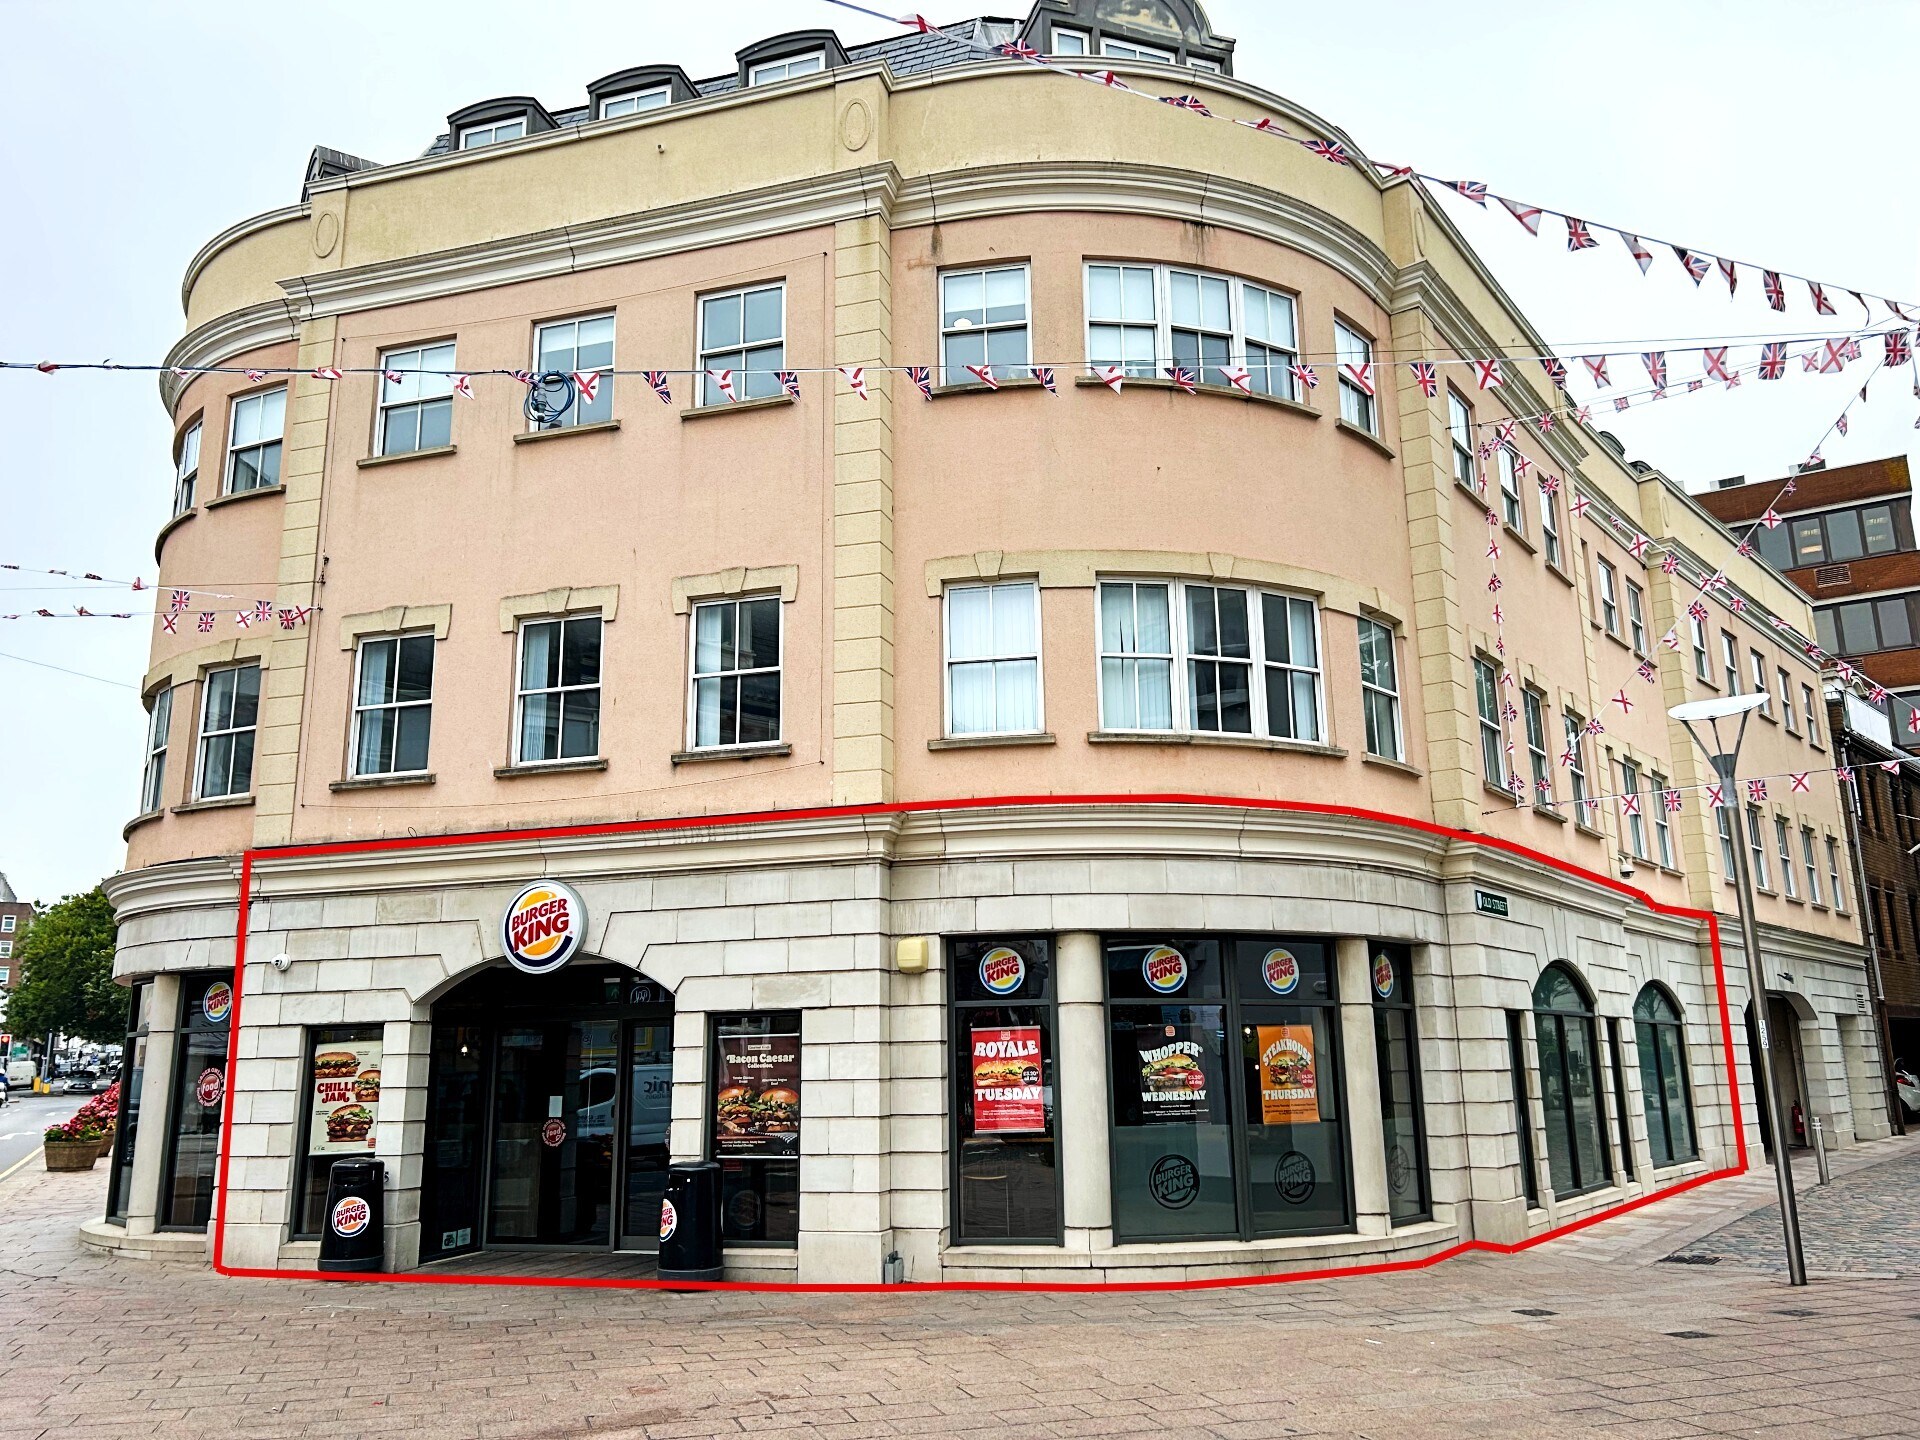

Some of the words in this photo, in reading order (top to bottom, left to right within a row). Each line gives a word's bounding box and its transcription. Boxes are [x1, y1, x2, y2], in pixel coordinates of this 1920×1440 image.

[1483, 896, 1492, 908] OLD
[1492, 898, 1507, 912] STREET
[512, 898, 567, 932] BURGER
[513, 912, 570, 952] KING
[985, 956, 1018, 973] BURGER
[1148, 955, 1180, 971] BURGER
[1267, 957, 1293, 972] BURGER
[986, 963, 1020, 984] KING
[1150, 962, 1182, 982] KING
[1268, 965, 1295, 983] KING
[207, 988, 229, 1004] BURGER
[207, 995, 230, 1012] KING
[974, 1040, 1039, 1058] ROYALE
[1263, 1038, 1312, 1067] STEAKHOUSE
[726, 1054, 758, 1064] Bacon
[759, 1053, 795, 1063] Caesar
[201, 1079, 220, 1095] food
[317, 1081, 356, 1093] CHILLI
[975, 1086, 1042, 1101] TUESDAY
[1263, 1089, 1316, 1100] THURSDAY
[321, 1091, 350, 1104] JAM
[1142, 1090, 1207, 1102] WEDNESDAY
[1155, 1164, 1192, 1185] BURGER
[1280, 1160, 1309, 1181] BURGER
[1157, 1173, 1194, 1199] KING
[1281, 1169, 1311, 1194] KING
[336, 1203, 366, 1218] BURGER
[336, 1211, 367, 1229] KING
